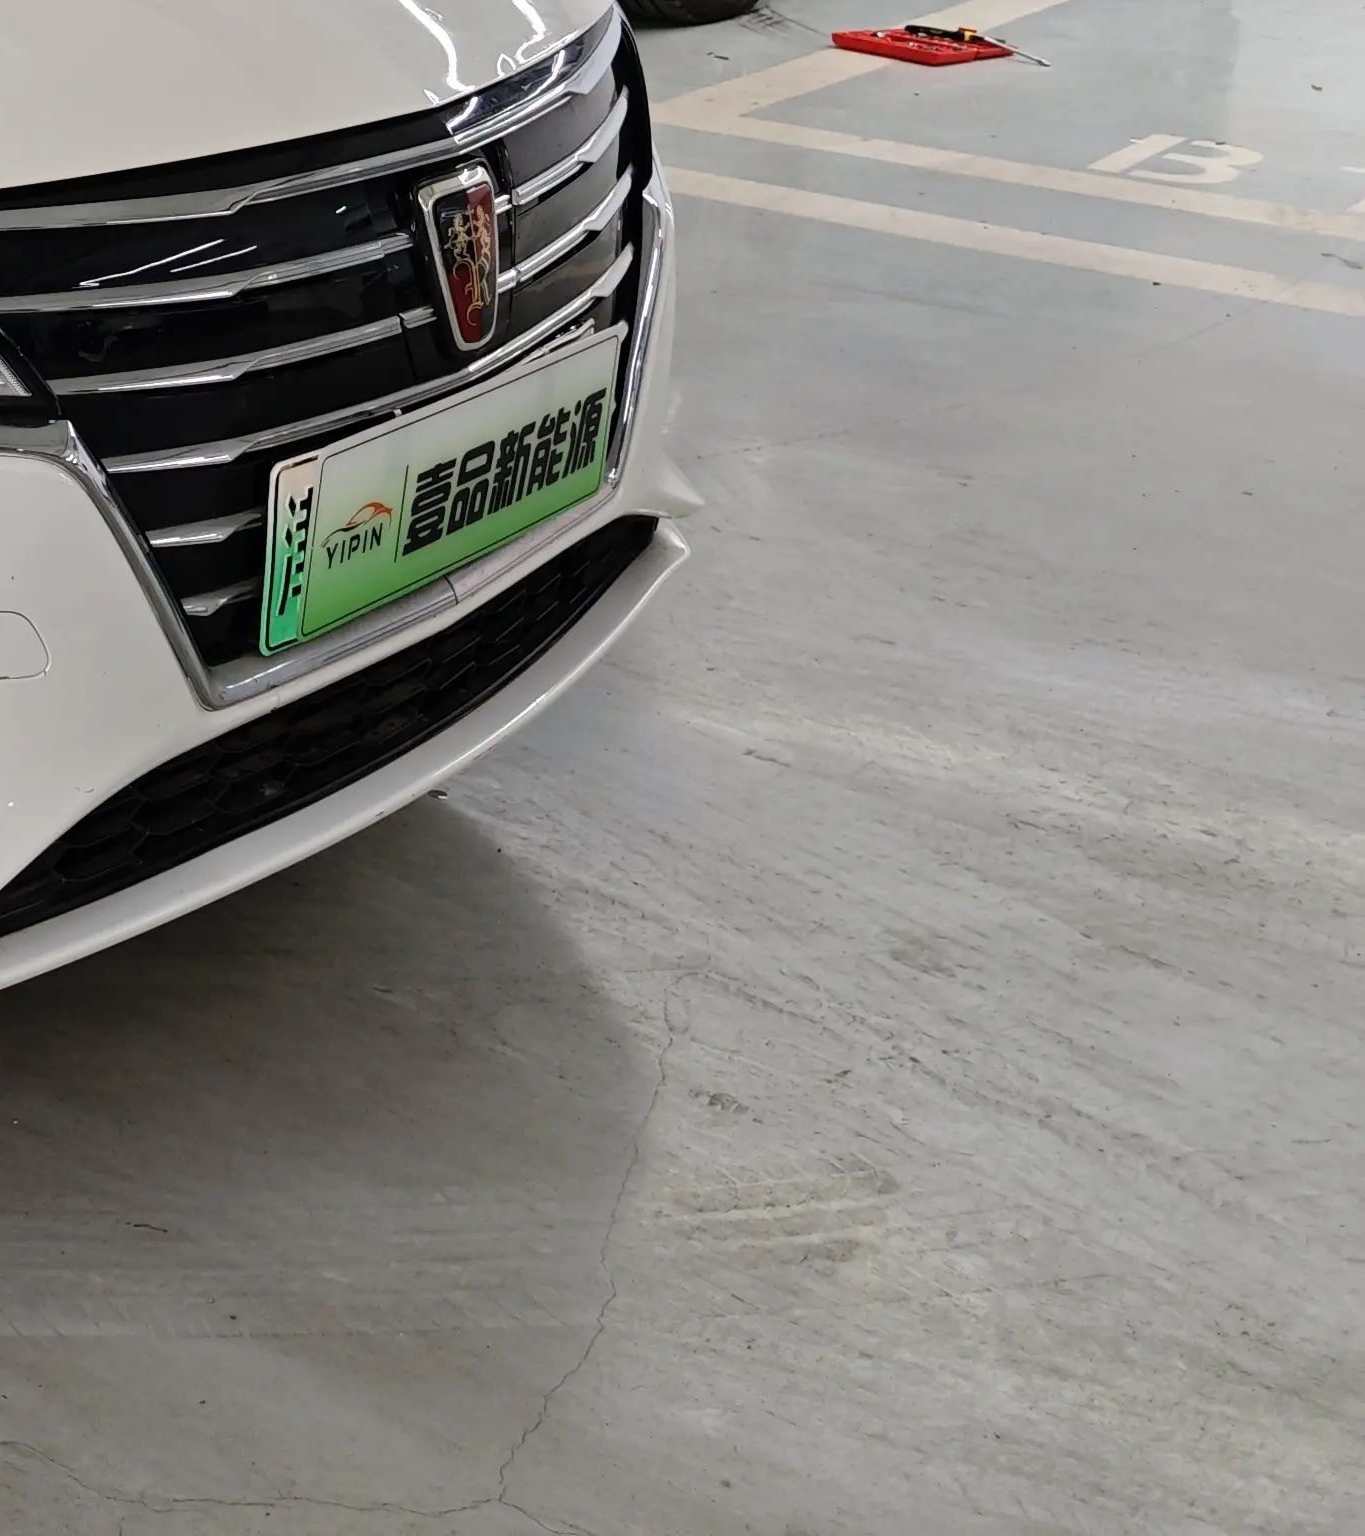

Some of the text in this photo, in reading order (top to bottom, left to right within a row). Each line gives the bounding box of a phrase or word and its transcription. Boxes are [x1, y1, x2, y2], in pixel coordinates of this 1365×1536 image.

[401, 387, 608, 557] 壹品新能源
[325, 521, 384, 570] YIPIN
